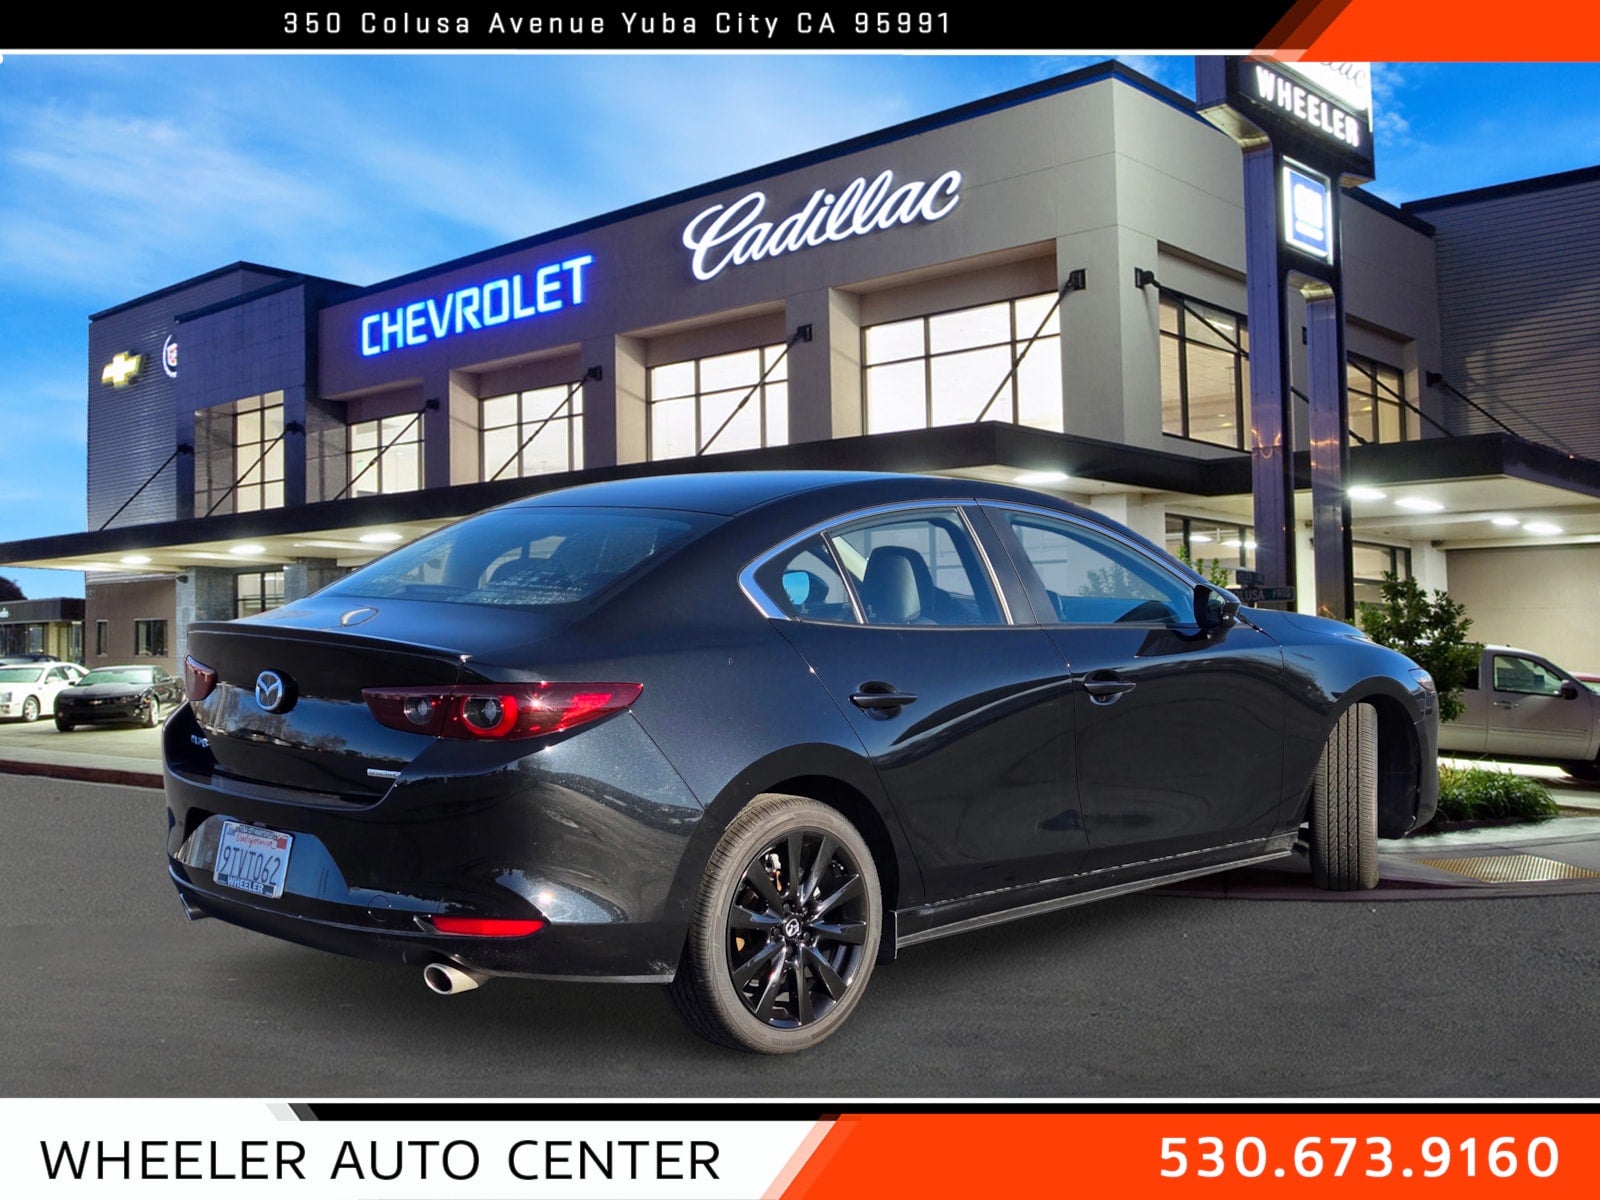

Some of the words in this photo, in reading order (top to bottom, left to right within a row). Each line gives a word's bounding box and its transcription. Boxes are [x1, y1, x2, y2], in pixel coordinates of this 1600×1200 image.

[1254, 66, 1360, 148] WHEELER
[682, 169, 963, 282] Cadillac
[361, 254, 593, 356] CHEVROLET
[219, 845, 281, 886] 9TVT062
[226, 875, 264, 895] WHEELER
